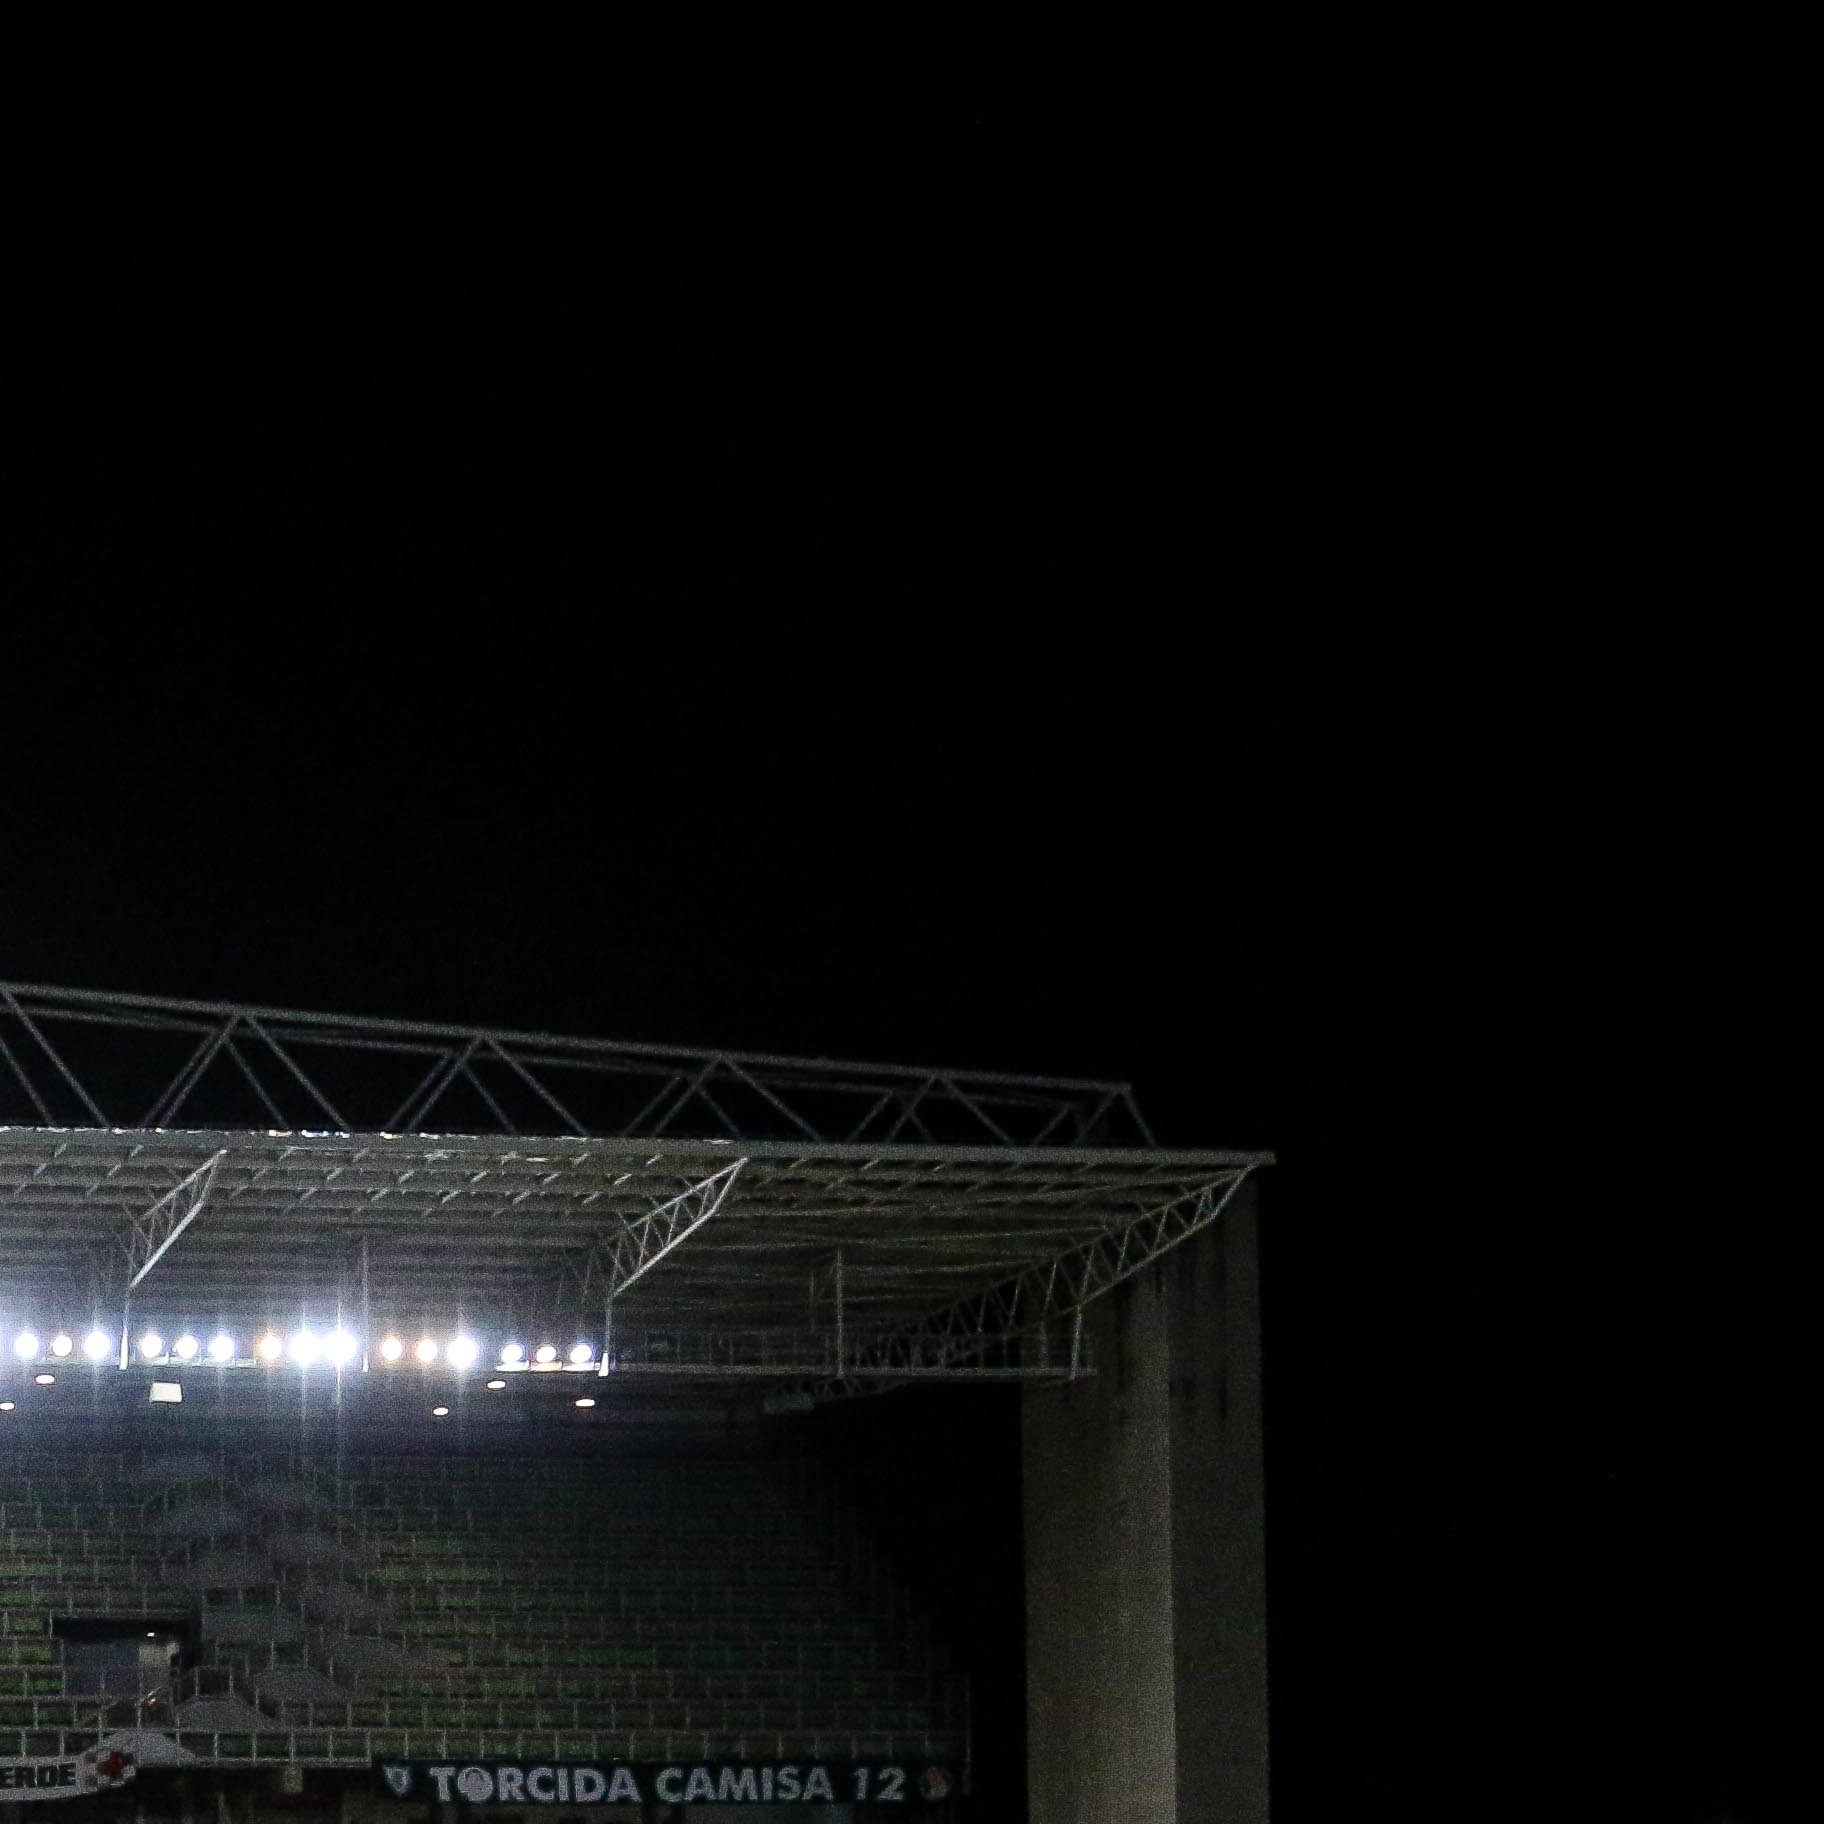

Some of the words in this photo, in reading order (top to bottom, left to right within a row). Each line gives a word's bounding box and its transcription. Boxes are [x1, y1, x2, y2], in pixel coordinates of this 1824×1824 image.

[430, 1766, 641, 1802] TORCIDA
[655, 1766, 834, 1801] CAMISA
[853, 1767, 905, 1800] 12
